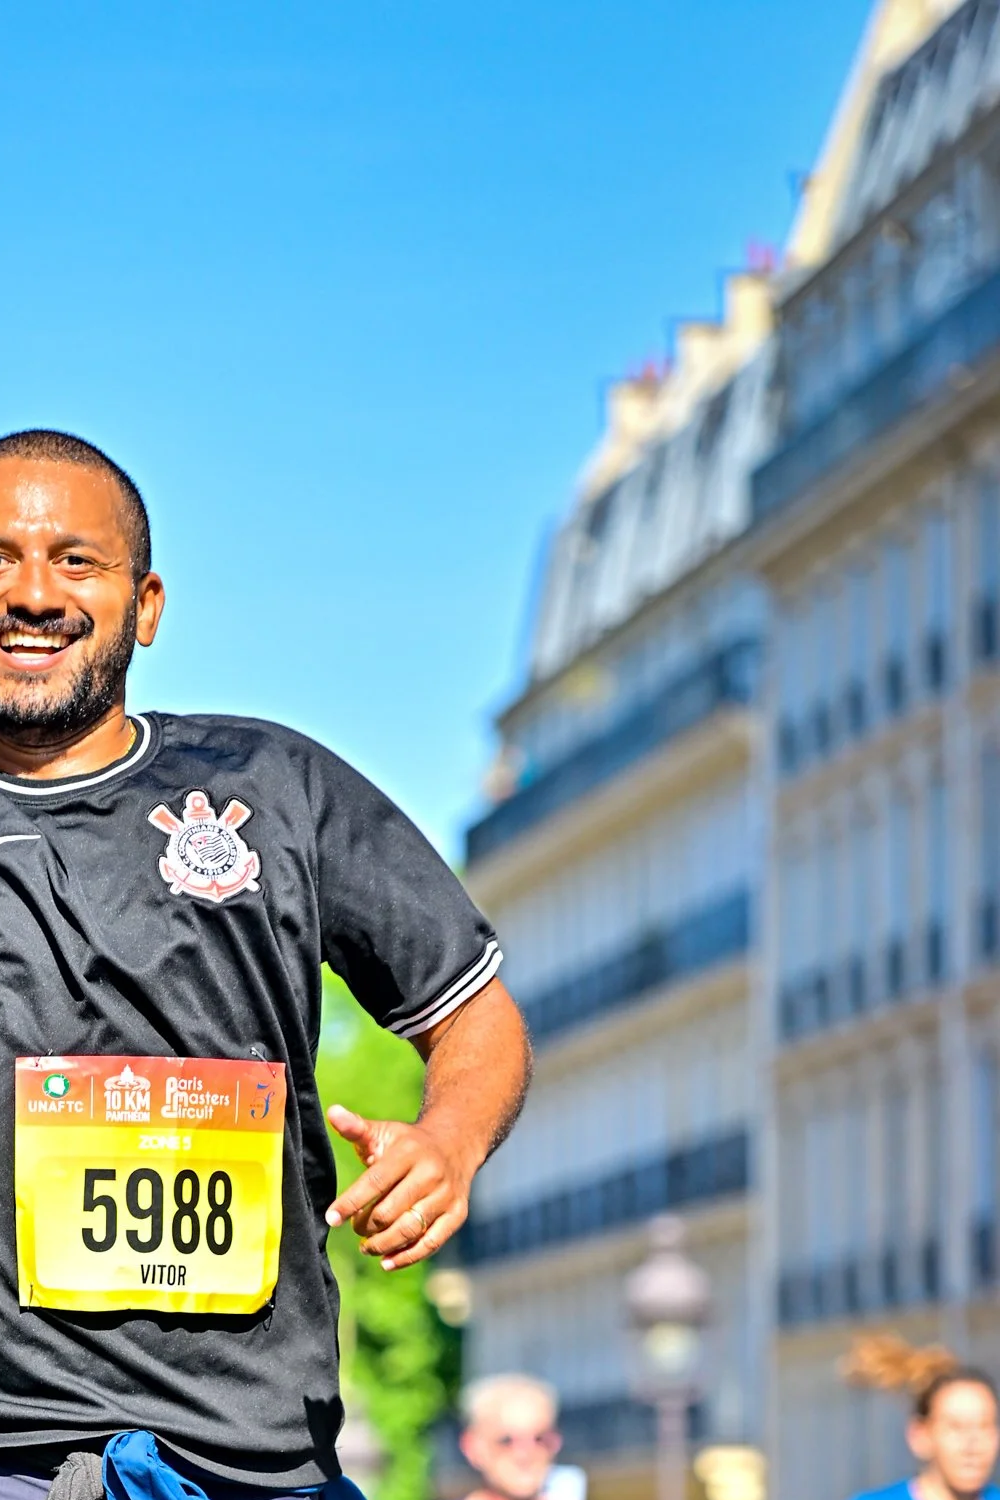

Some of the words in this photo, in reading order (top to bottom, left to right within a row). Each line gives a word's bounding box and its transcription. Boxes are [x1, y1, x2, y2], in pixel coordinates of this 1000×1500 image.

[103, 1090, 121, 1110] 10
[124, 1090, 150, 1111] KM
[138, 1134, 180, 1150] ZONE
[81, 1167, 233, 1256] 5988
[140, 1263, 187, 1286] VITOR
